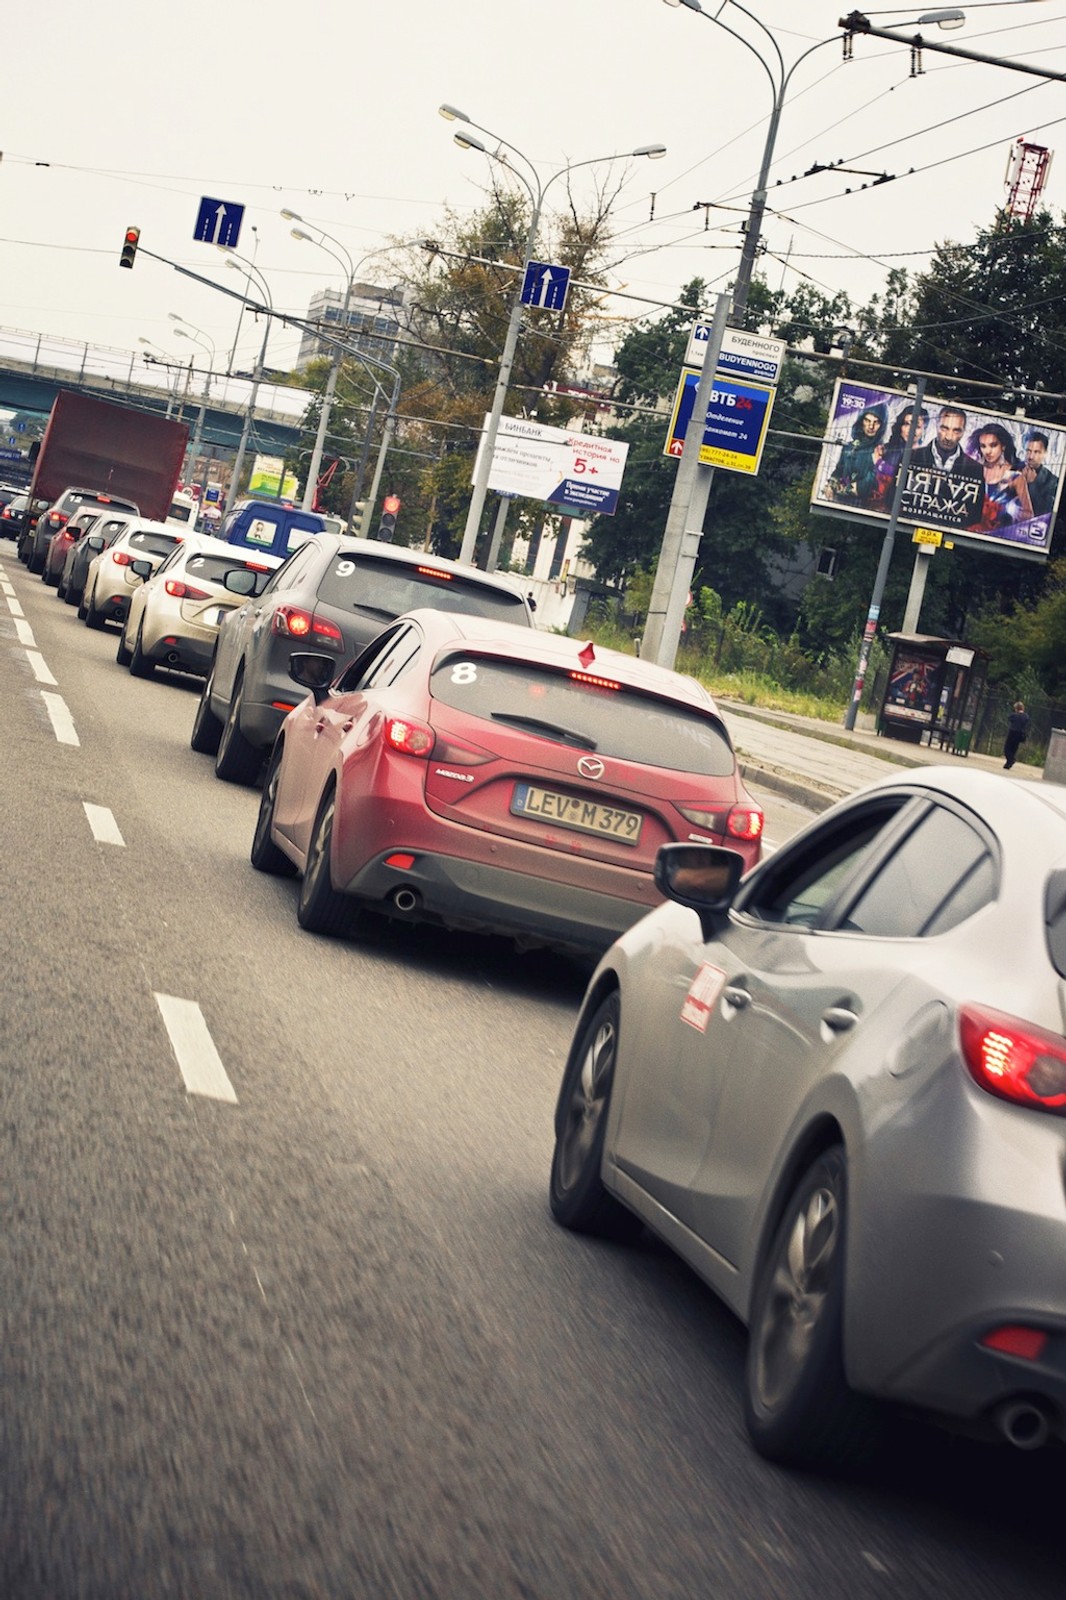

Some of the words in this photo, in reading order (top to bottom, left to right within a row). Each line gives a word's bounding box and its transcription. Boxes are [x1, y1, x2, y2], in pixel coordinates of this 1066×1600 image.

[731, 336, 780, 352] БУДЕННОГО
[719, 353, 776, 372] BUDYENNOGO
[706, 411, 744, 426] Отделение
[504, 423, 543, 437] БИНБАНК
[568, 437, 613, 454] Кредитная
[572, 448, 607, 461] история
[573, 459, 598, 475] 5+
[949, 473, 981, 485] ДЕТЕКТИВ
[69, 494, 83, 504] 12
[900, 490, 969, 516] СТРАЖА
[903, 505, 961, 525] ВОЗВРАЩАЕТСЯ
[135, 533, 145, 543] 4
[191, 557, 204, 568] 2
[336, 561, 355, 577] 9
[451, 662, 477, 684] 8
[526, 790, 570, 819] LEV
[580, 804, 597, 825] M
[598, 809, 639, 836] 379
